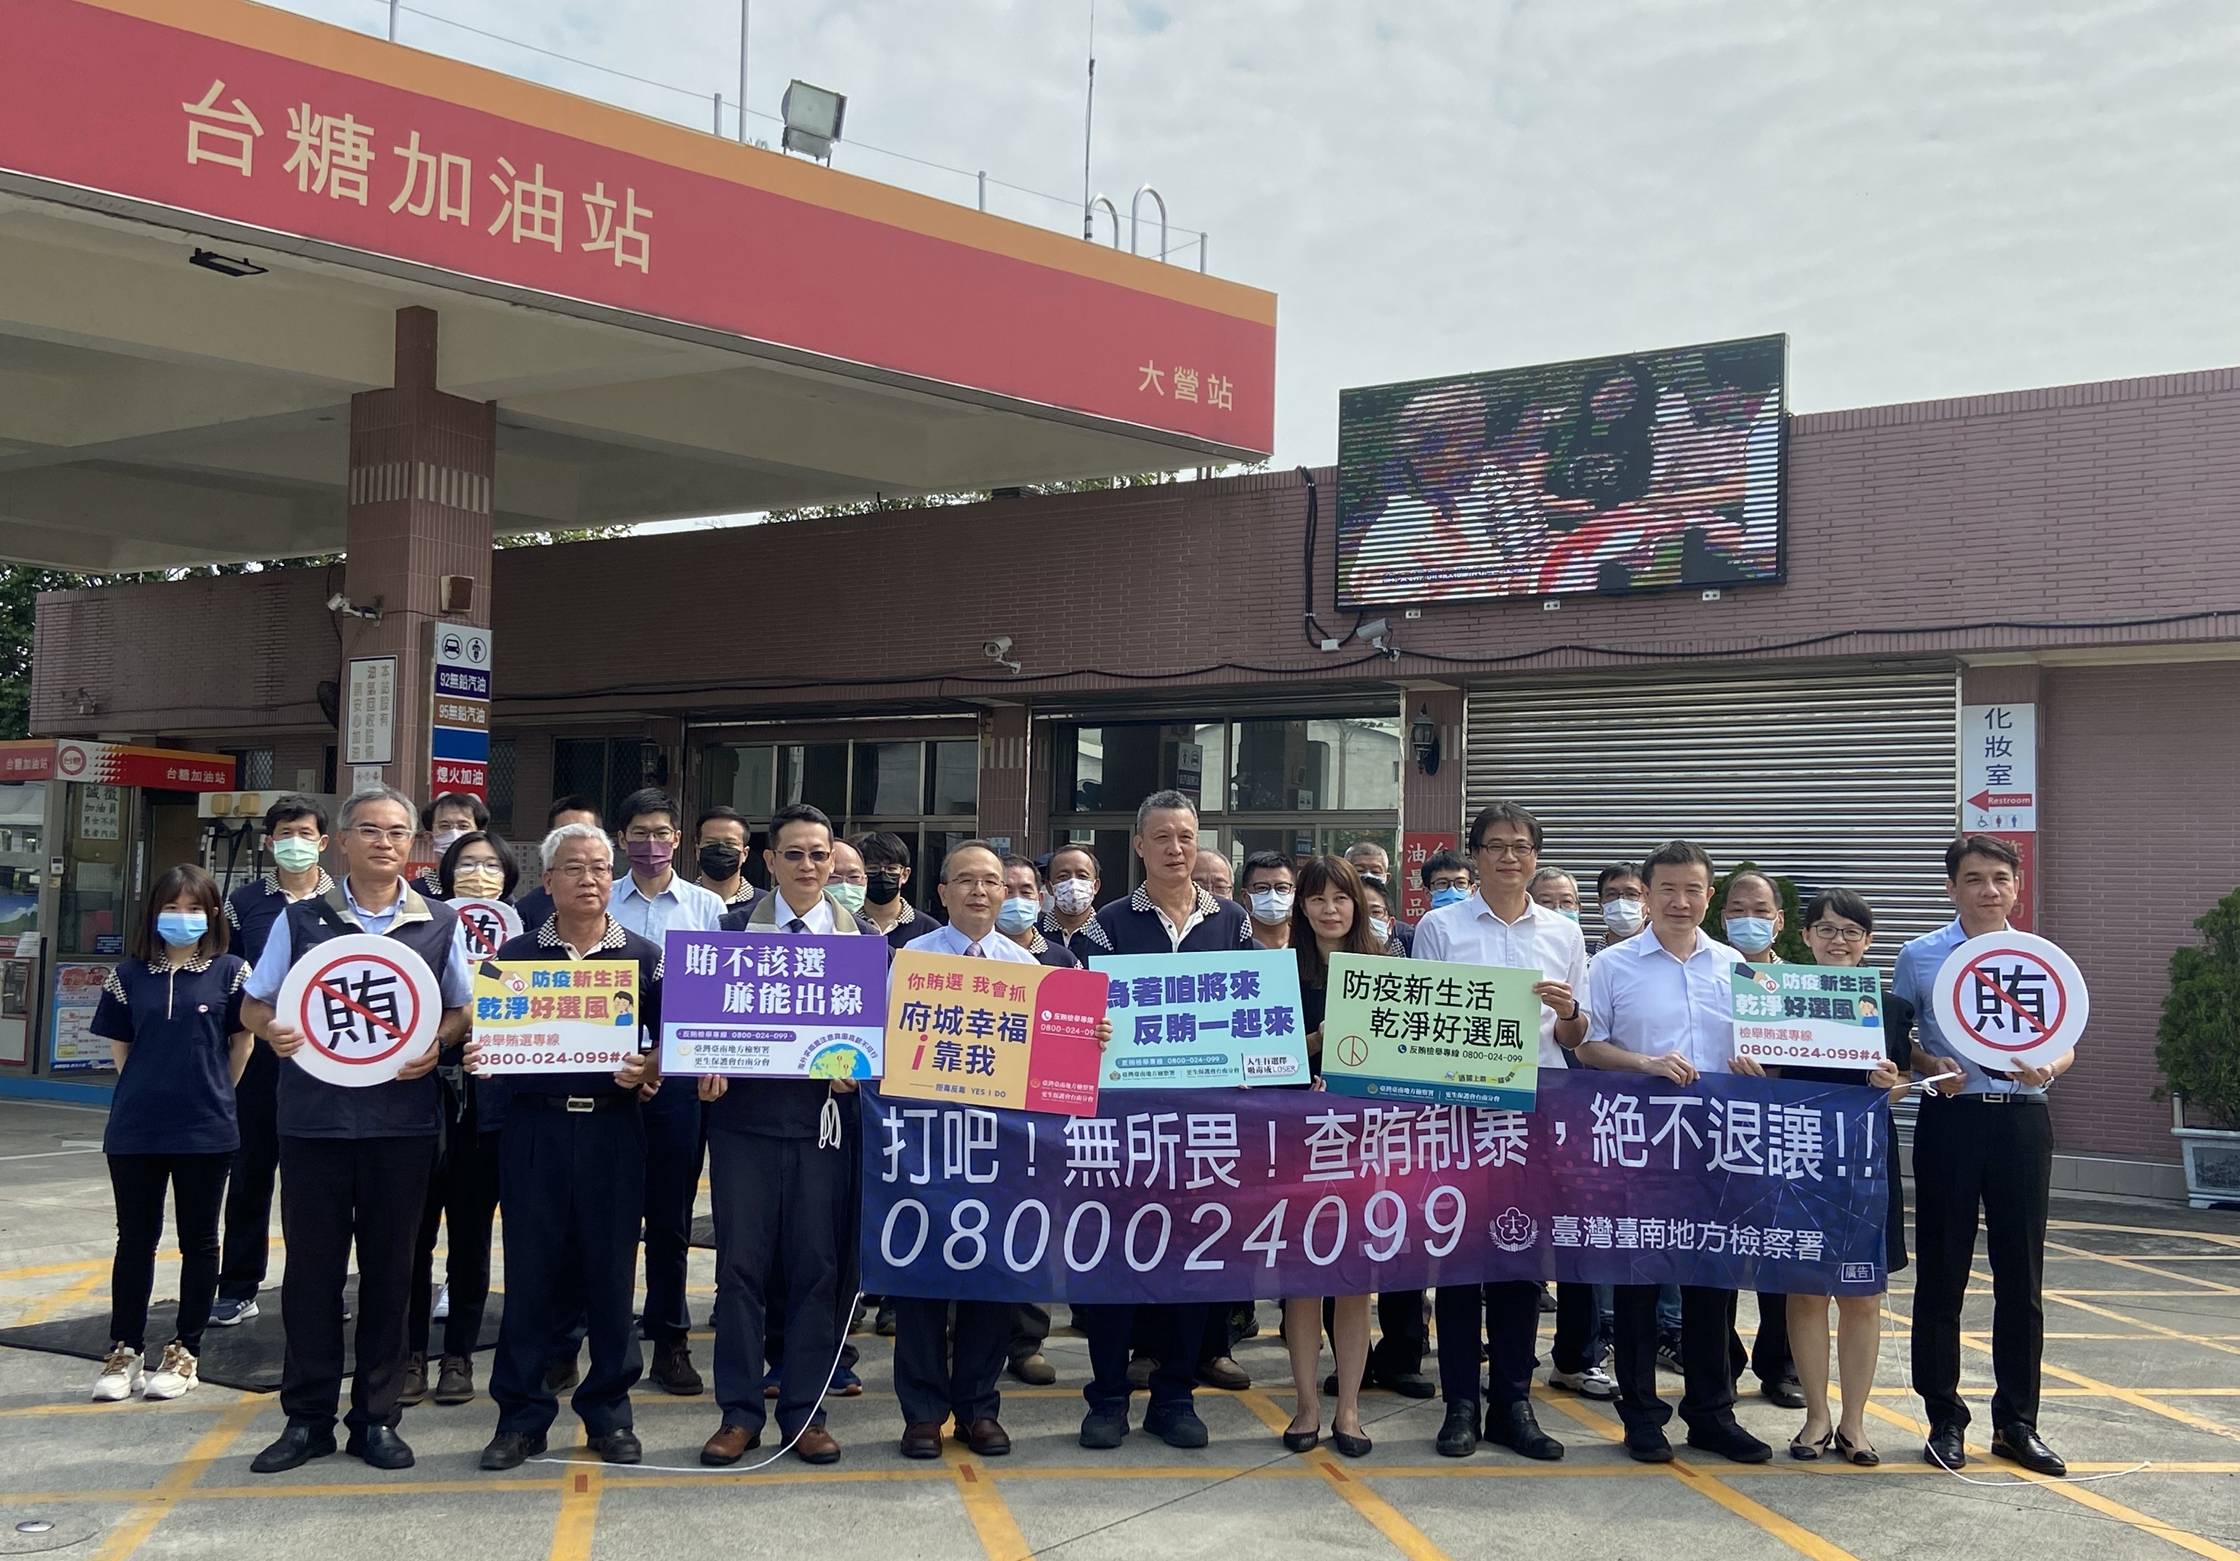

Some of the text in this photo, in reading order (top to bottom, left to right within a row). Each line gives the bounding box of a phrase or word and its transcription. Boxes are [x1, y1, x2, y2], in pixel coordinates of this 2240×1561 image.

[181, 79, 654, 274] 台糖加油站
[1138, 359, 1233, 411] 大營站
[439, 672, 487, 693] 92無鉛汽油
[438, 704, 486, 724] 95無鉛汽油
[1984, 707, 2013, 787] 化妝室
[6, 757, 49, 770] 台糖加油站
[436, 766, 484, 786] 熄火加油
[166, 768, 227, 785] 台糖加油站
[1988, 796, 2031, 805] Restroom
[684, 943, 827, 979] 賄不該選
[531, 970, 633, 988] 防疫新生活
[906, 972, 1027, 1003] 你賄選 我會抓
[1107, 970, 1261, 1009] 為著咱將來
[1343, 969, 1496, 1012] 防疫新生活
[1782, 973, 1877, 993] 防疫新生活
[321, 970, 402, 1051] 賄
[476, 995, 610, 1020] 乾淨好選風
[722, 981, 863, 1016] 廉能出線
[1735, 994, 1857, 1020] 乾淨好選風
[1974, 965, 2047, 1034] 賄
[731, 1031, 788, 1040] 0800-024-099
[898, 1001, 1029, 1045] 府城幸福
[1040, 1024, 1095, 1036] 0800-024-09
[1133, 1006, 1295, 1046] 反賄一起來
[1369, 1006, 1524, 1051] 乾淨好選風
[1739, 1027, 1813, 1041] 檢舉賄選專線
[479, 1033, 560, 1047] 檢舉賄選專線
[1740, 1044, 1882, 1061] 0800-024-099#4
[1409, 1045, 1523, 1063] 反賄檢舉專線 0800-024-099
[971, 1087, 985, 1096] YES
[994, 1090, 1007, 1098] DO
[880, 1184, 1468, 1273] 0800024099
[1551, 1213, 1824, 1262] 臺灣臺南地方檢察署
[1845, 1265, 1870, 1279] 廣告
